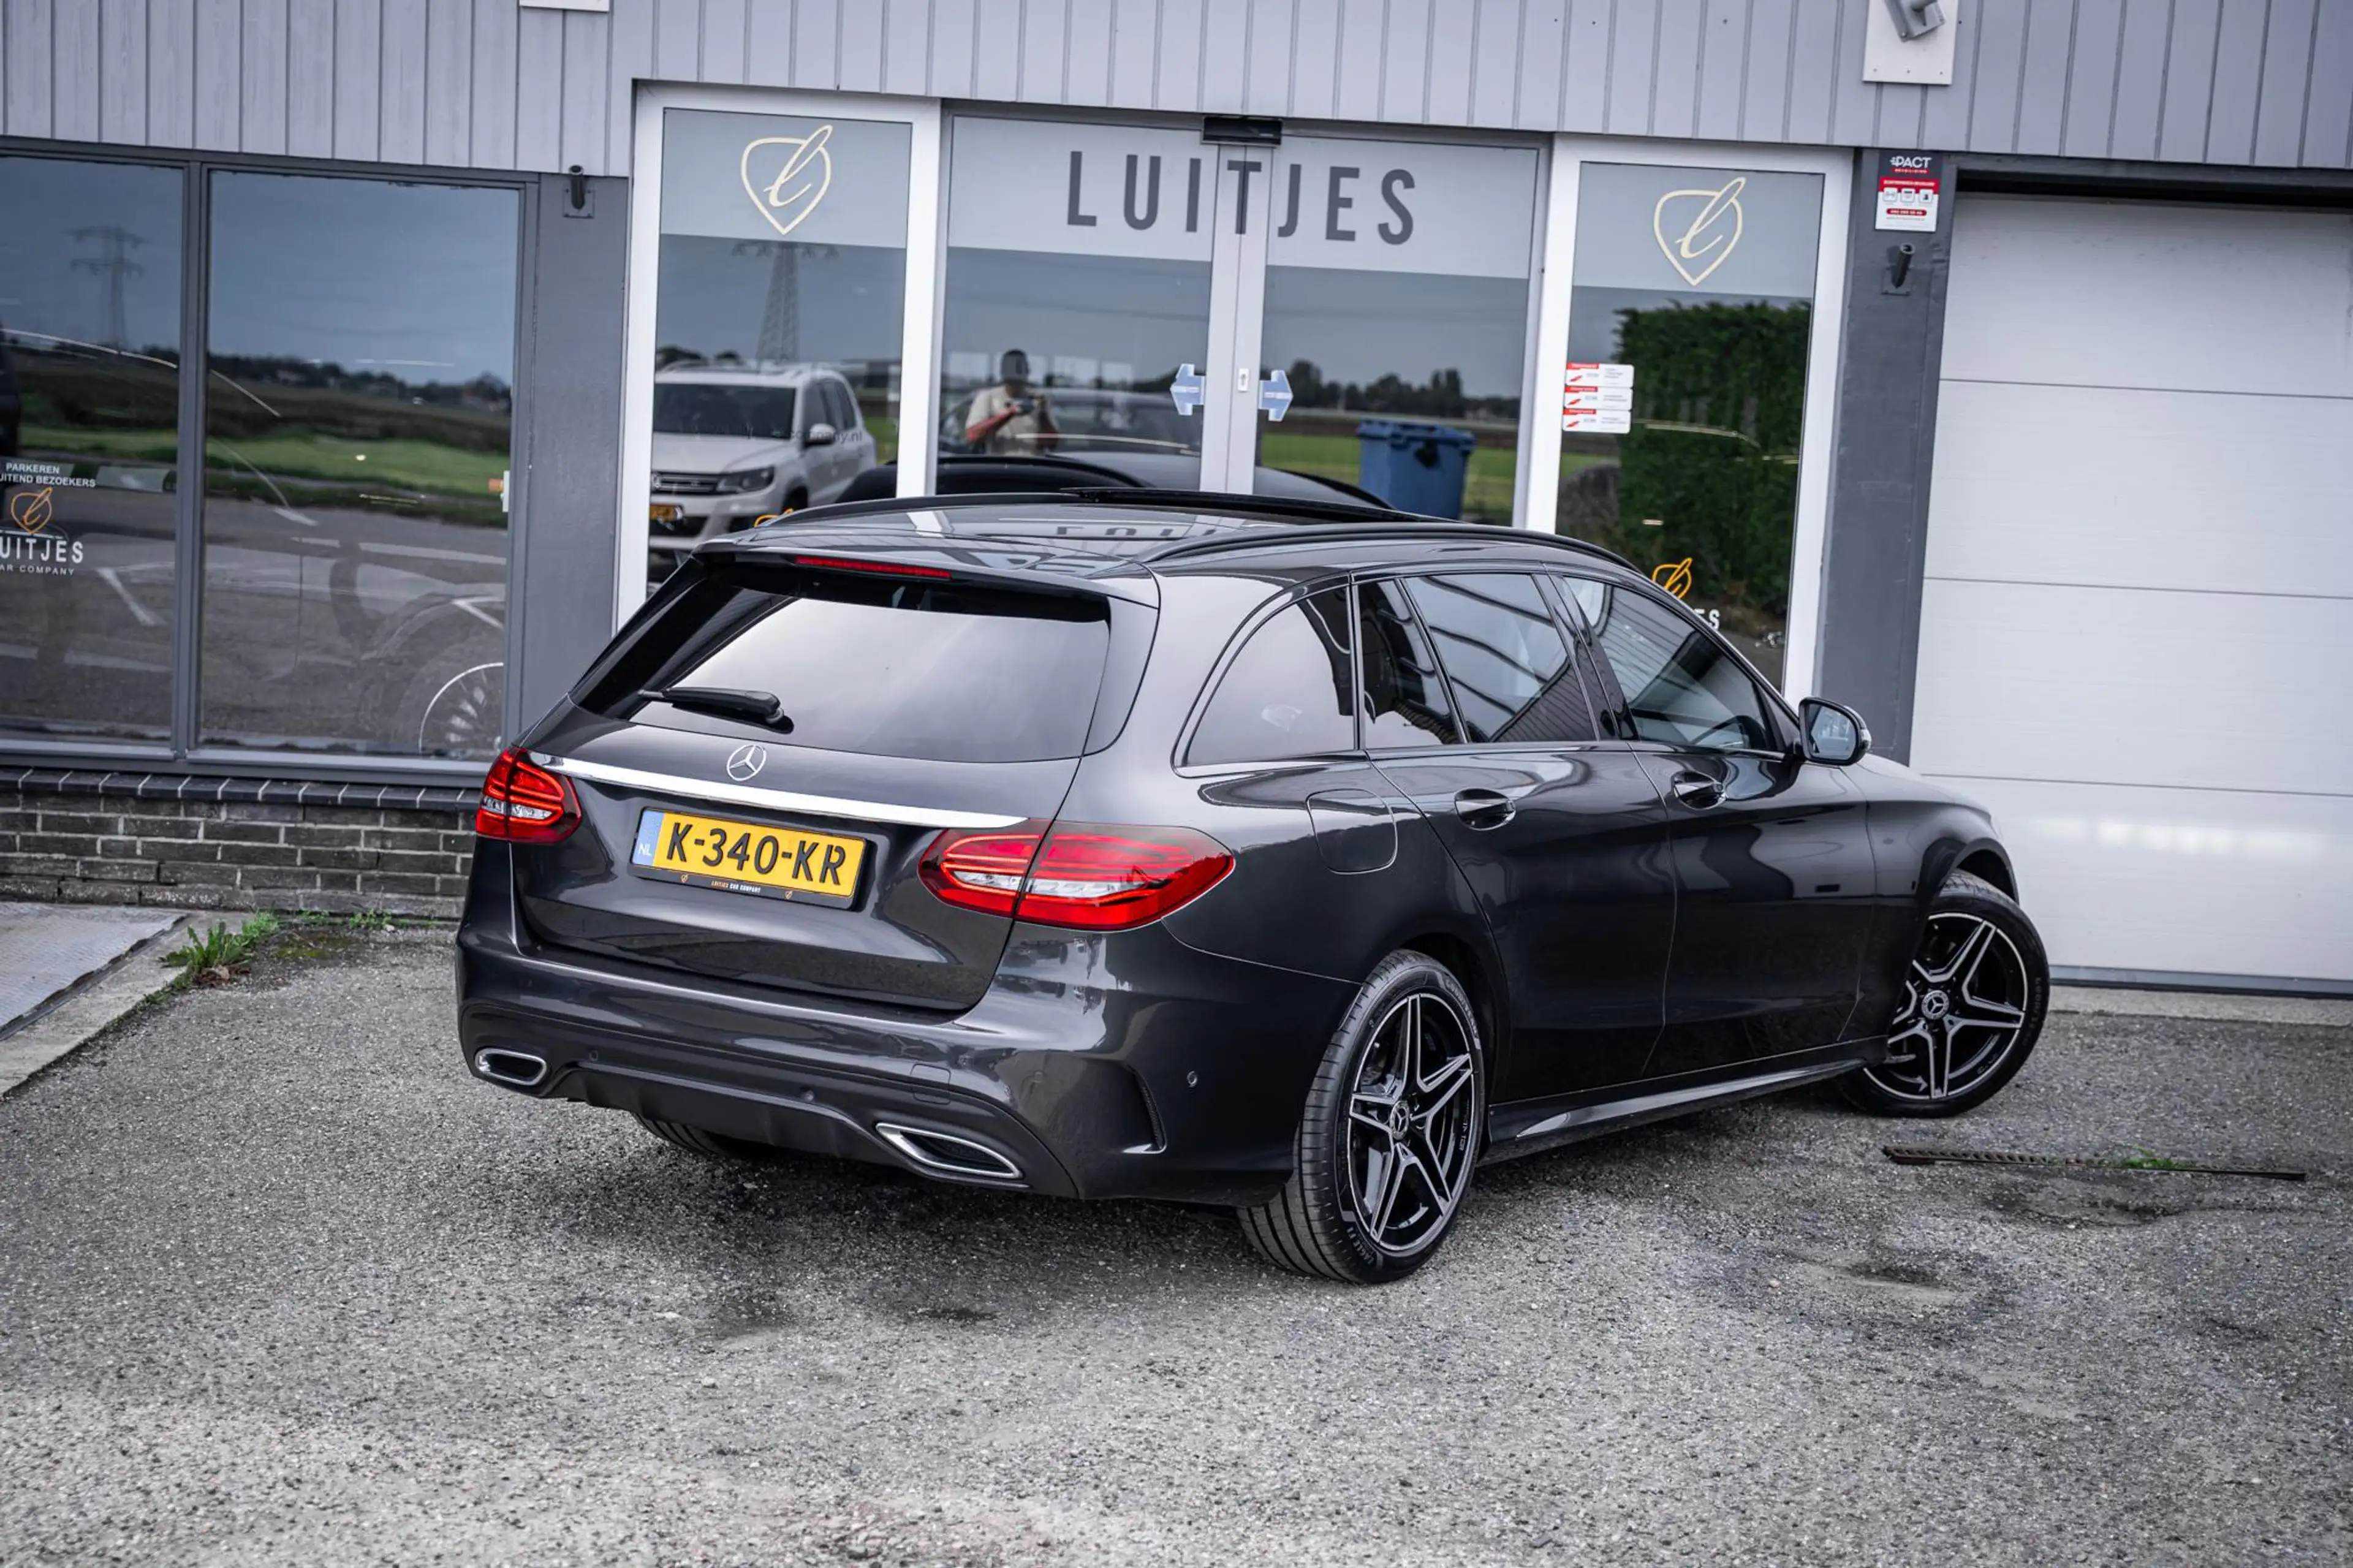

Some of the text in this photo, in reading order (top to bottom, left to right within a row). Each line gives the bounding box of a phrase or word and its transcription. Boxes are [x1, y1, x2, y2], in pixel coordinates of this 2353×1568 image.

[1890, 156, 1932, 168] PACT
[1067, 151, 1415, 245] LUITJES
[6, 463, 59, 474] PARKEREN
[36, 475, 96, 488] BEZOEKERS
[20, 565, 75, 576] COMPANY
[638, 822, 846, 886] NL K-340-KR
